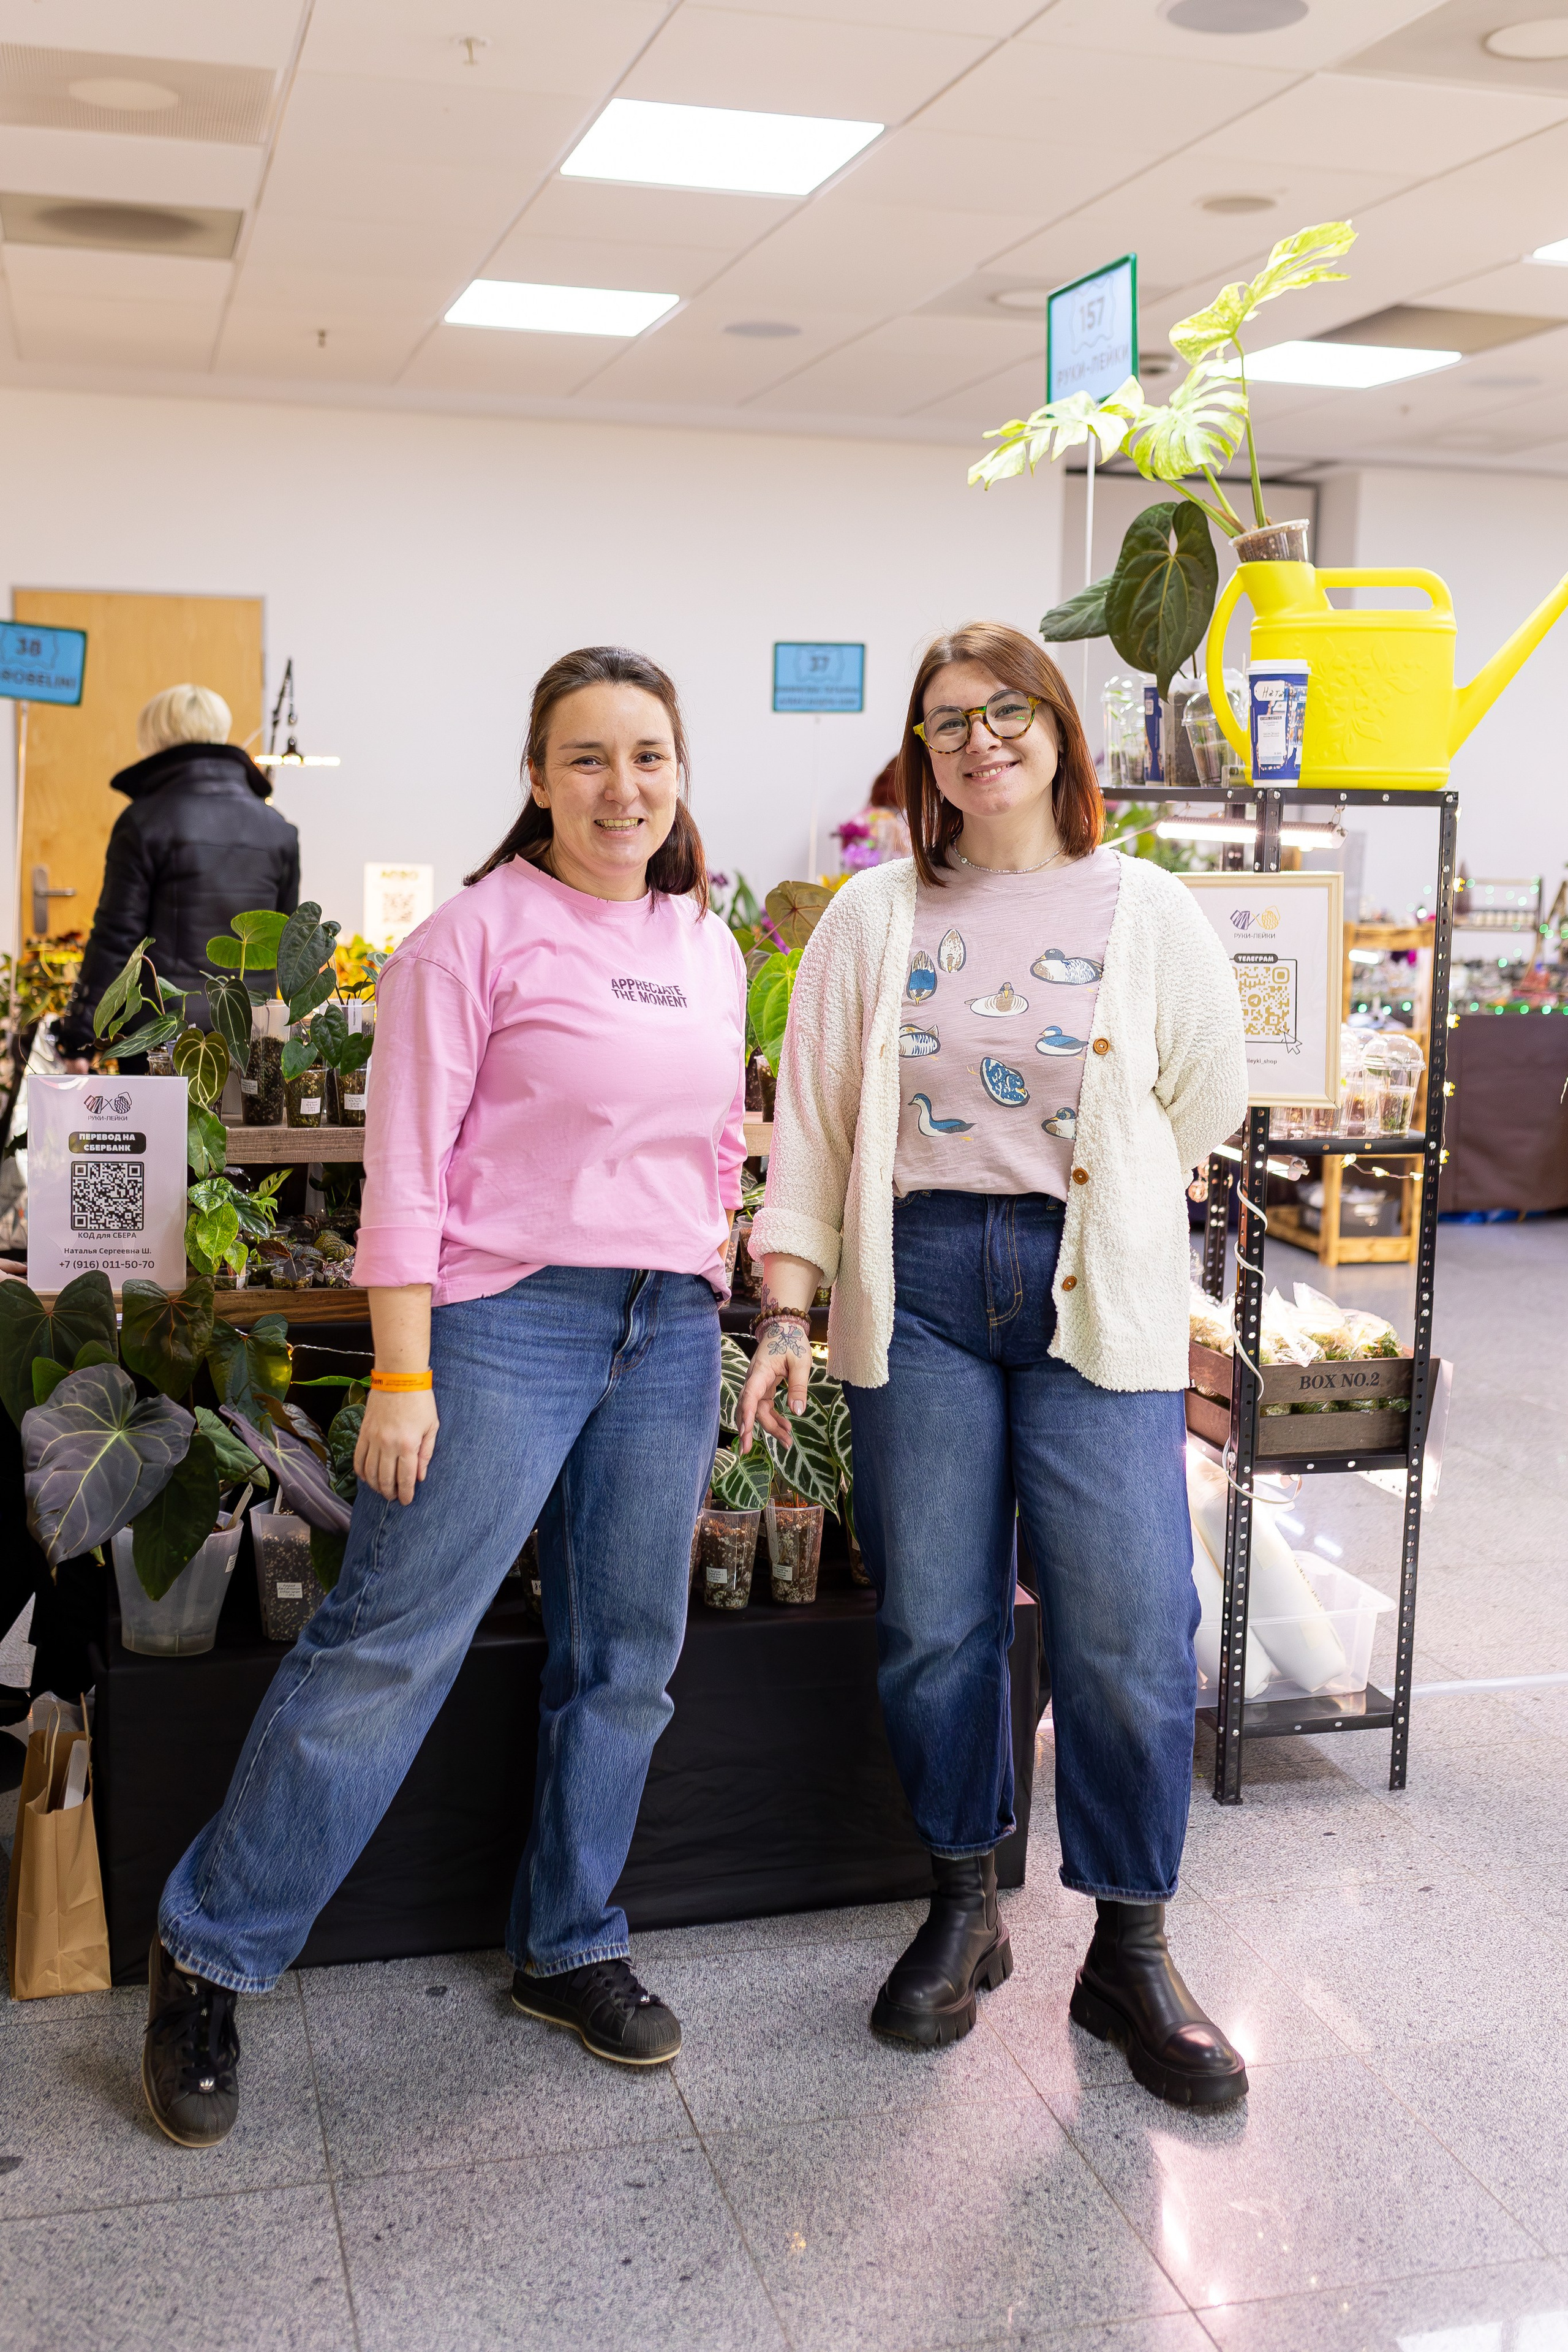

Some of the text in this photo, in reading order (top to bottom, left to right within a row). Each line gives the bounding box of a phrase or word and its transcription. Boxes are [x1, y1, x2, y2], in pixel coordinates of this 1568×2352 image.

[1080, 296, 1106, 332] 157
[611, 978, 683, 996] APPRECIATE
[611, 989, 687, 1008] THE MOMENT
[79, 1133, 121, 1142] ПЕРЕВОД
[73, 1260, 99, 1269] (916)
[1298, 1372, 1380, 1390] BOX NO.2
